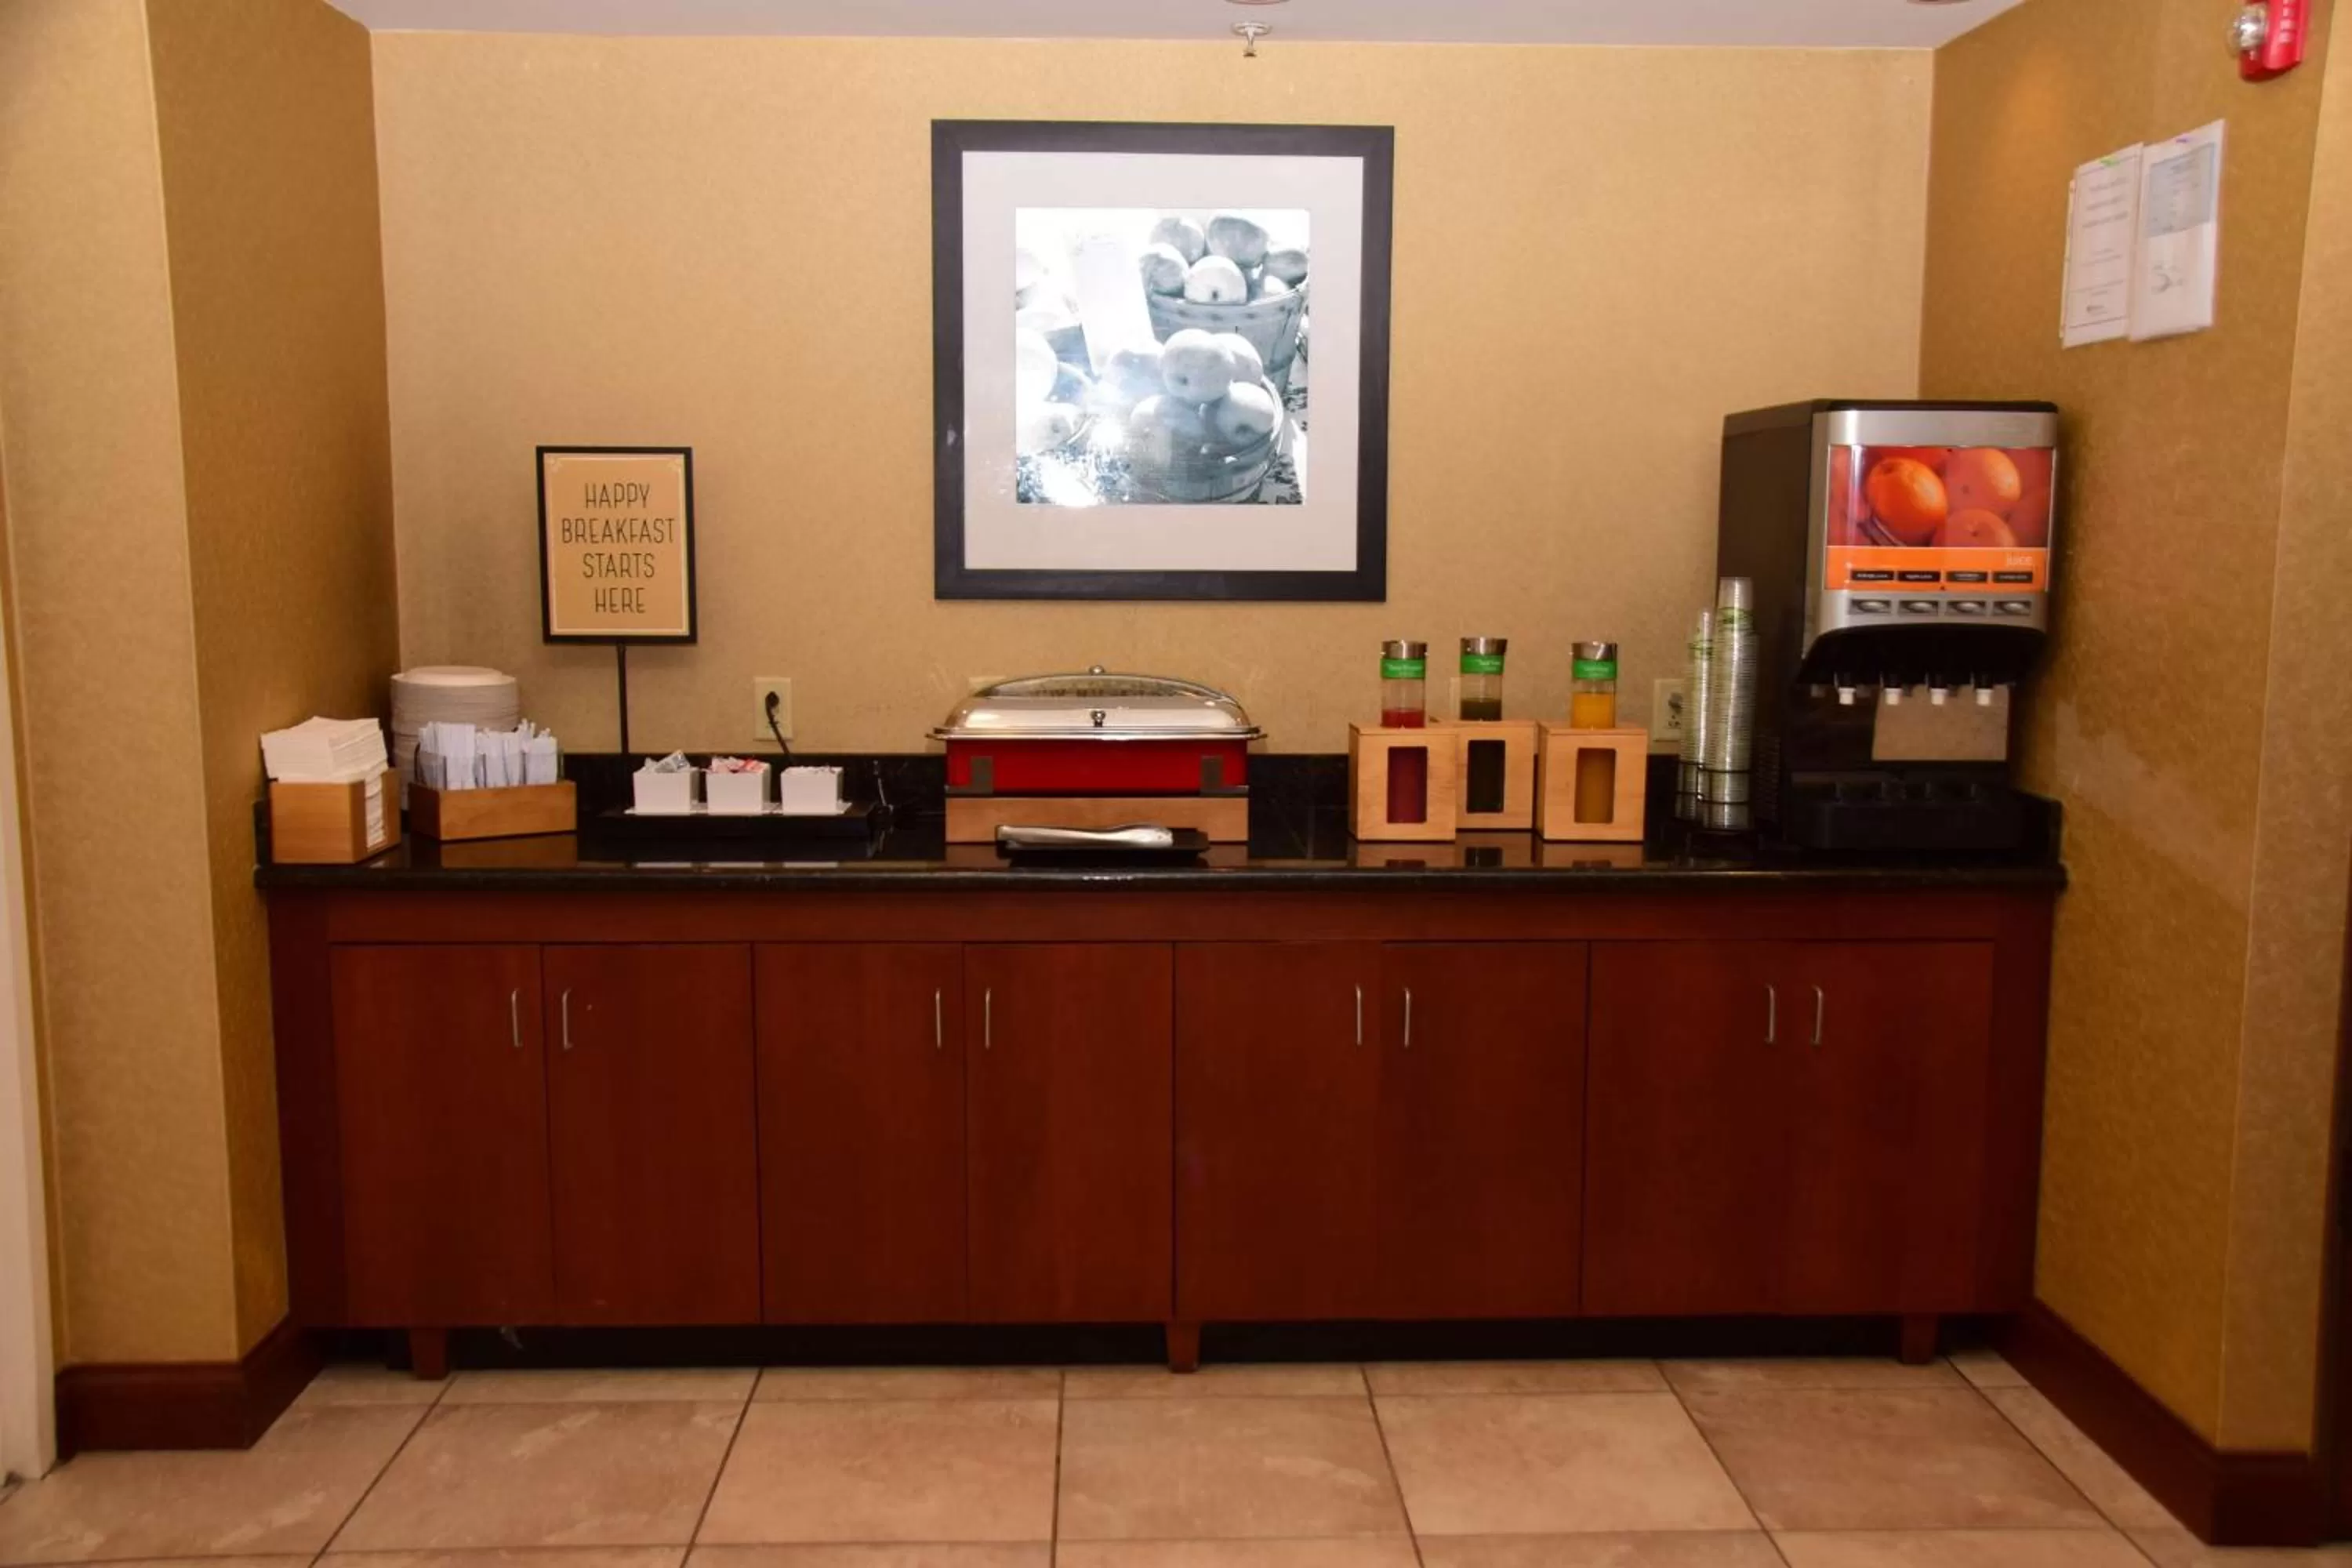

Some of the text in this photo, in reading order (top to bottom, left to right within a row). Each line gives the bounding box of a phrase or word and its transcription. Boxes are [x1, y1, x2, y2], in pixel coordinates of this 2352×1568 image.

[585, 482, 650, 508] HAPPY
[561, 517, 675, 544] BREAKFAST
[583, 553, 655, 579] STARTS
[595, 587, 646, 614] HERE
